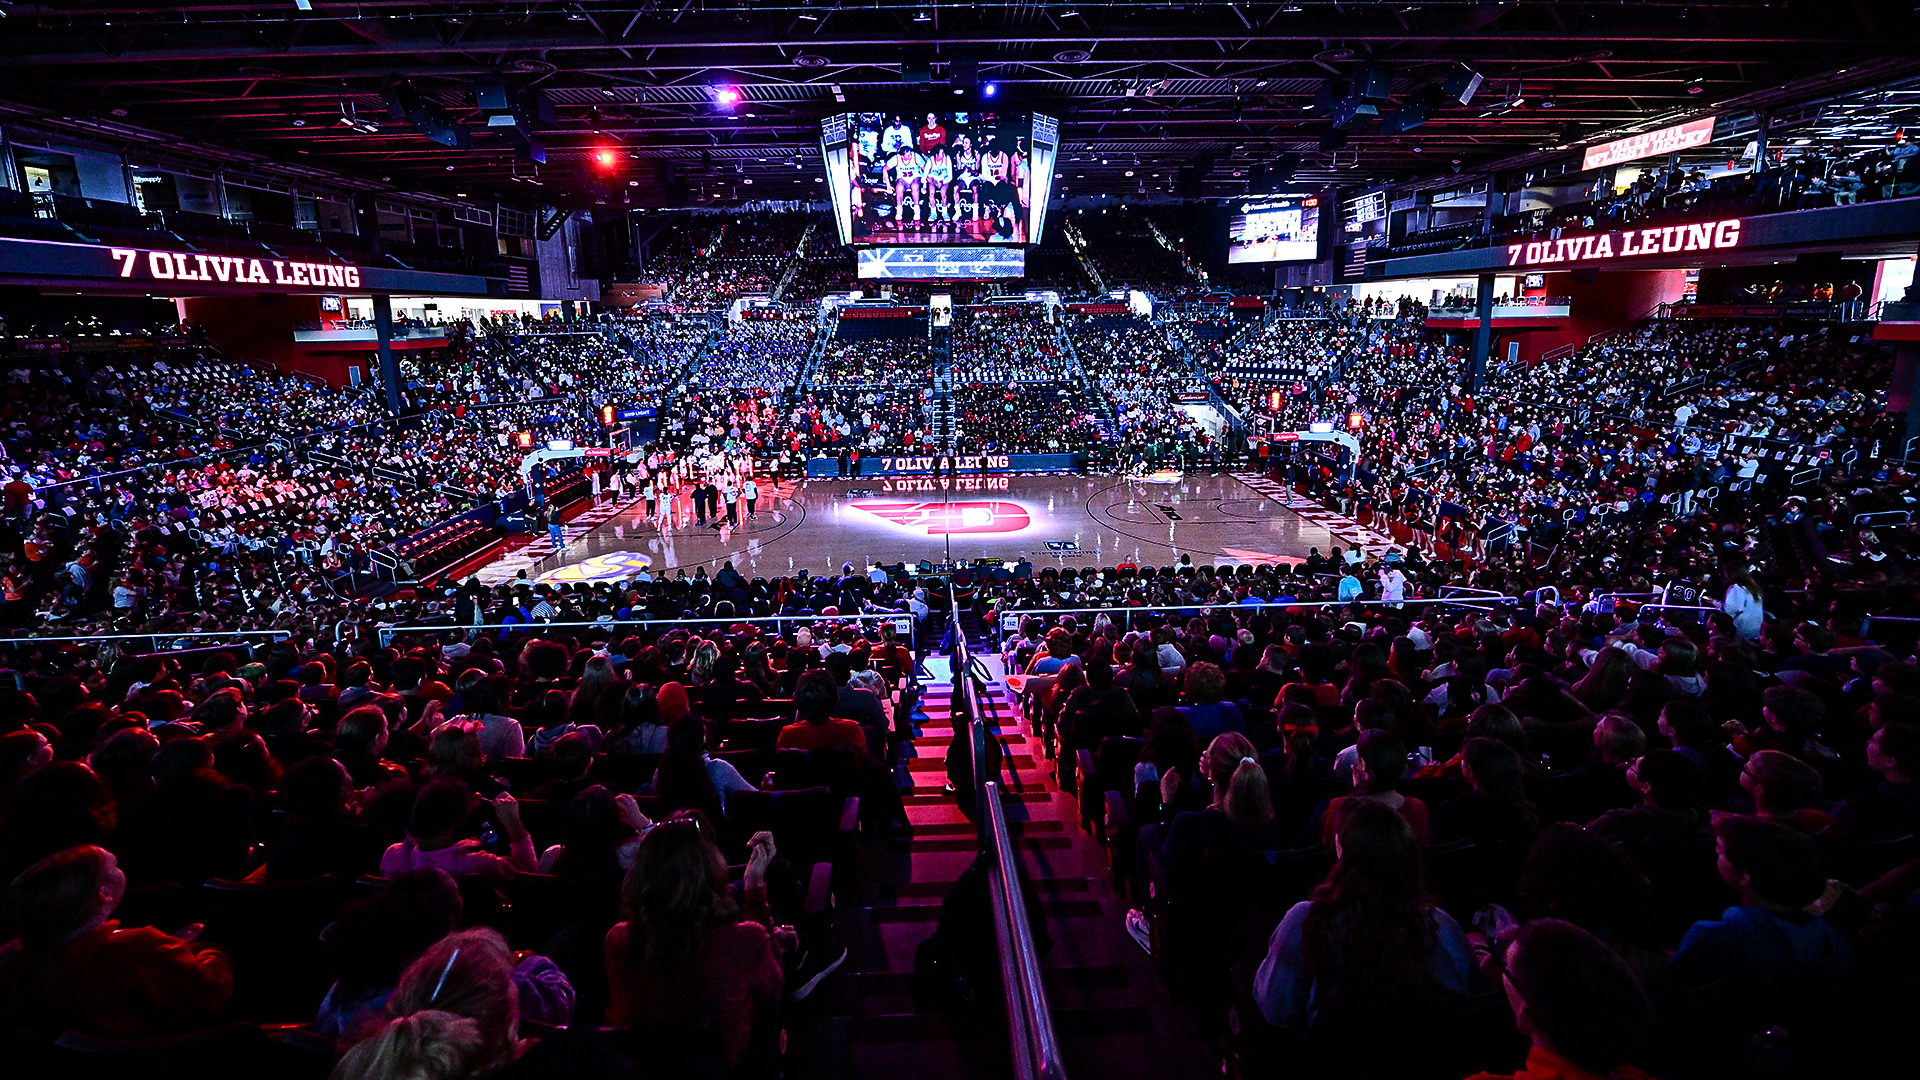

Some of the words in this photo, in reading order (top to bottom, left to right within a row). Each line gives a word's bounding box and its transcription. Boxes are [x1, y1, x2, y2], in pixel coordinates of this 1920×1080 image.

[1594, 145, 1650, 166] FLIGHT
[1650, 131, 1700, 155] DECK
[1508, 244, 1522, 266] 7
[1525, 234, 1614, 265] OLIVIA
[1619, 219, 1741, 257] LEUNG
[111, 250, 136, 278] 7
[149, 251, 270, 284] OLIVIA
[273, 260, 360, 288] LEUNG
[881, 458, 892, 471] 7
[895, 456, 949, 471] OLIVA
[1672, 585, 1697, 602] 30
